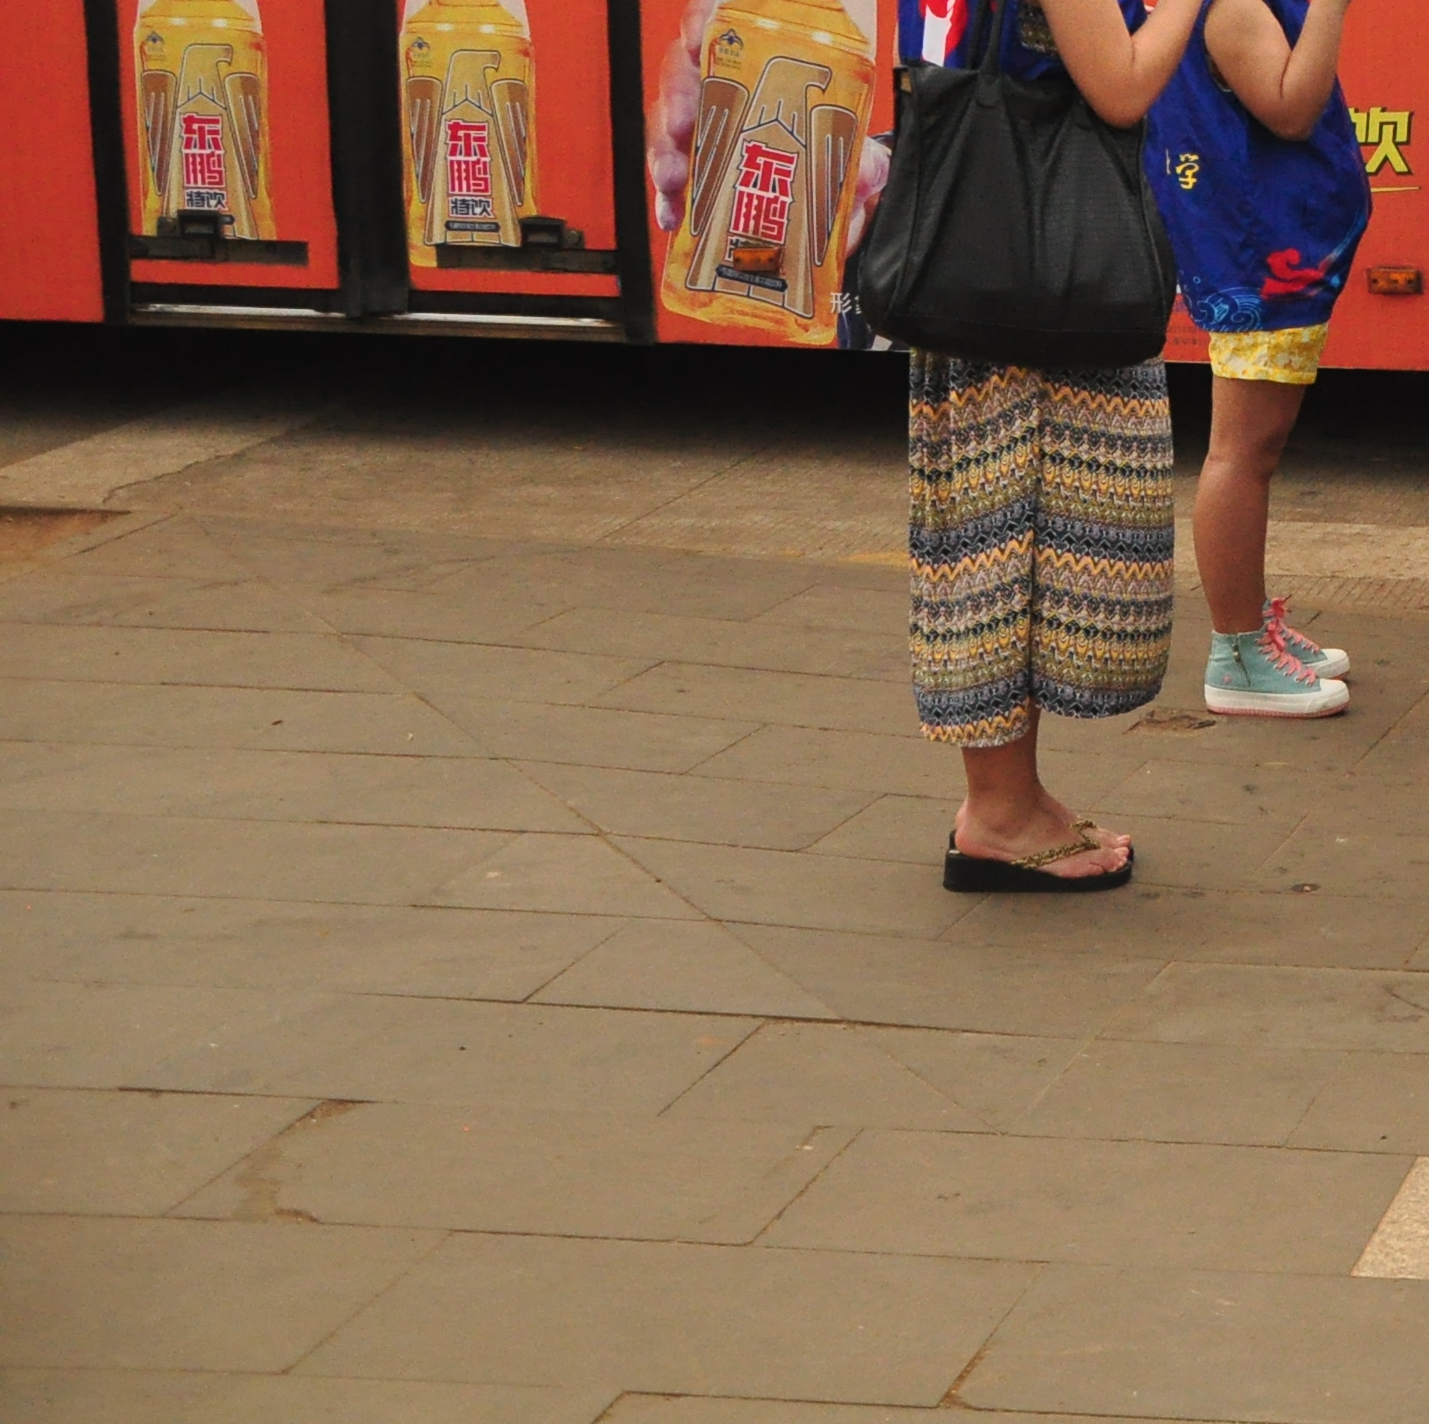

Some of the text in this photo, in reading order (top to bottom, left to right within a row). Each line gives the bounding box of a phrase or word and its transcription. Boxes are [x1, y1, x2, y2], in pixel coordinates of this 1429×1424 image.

[181, 113, 225, 186] 东鹏
[446, 120, 491, 194] 东鹏
[186, 190, 227, 209] 特饮
[450, 197, 493, 217] 特饮
[730, 141, 798, 244] 东鹏
